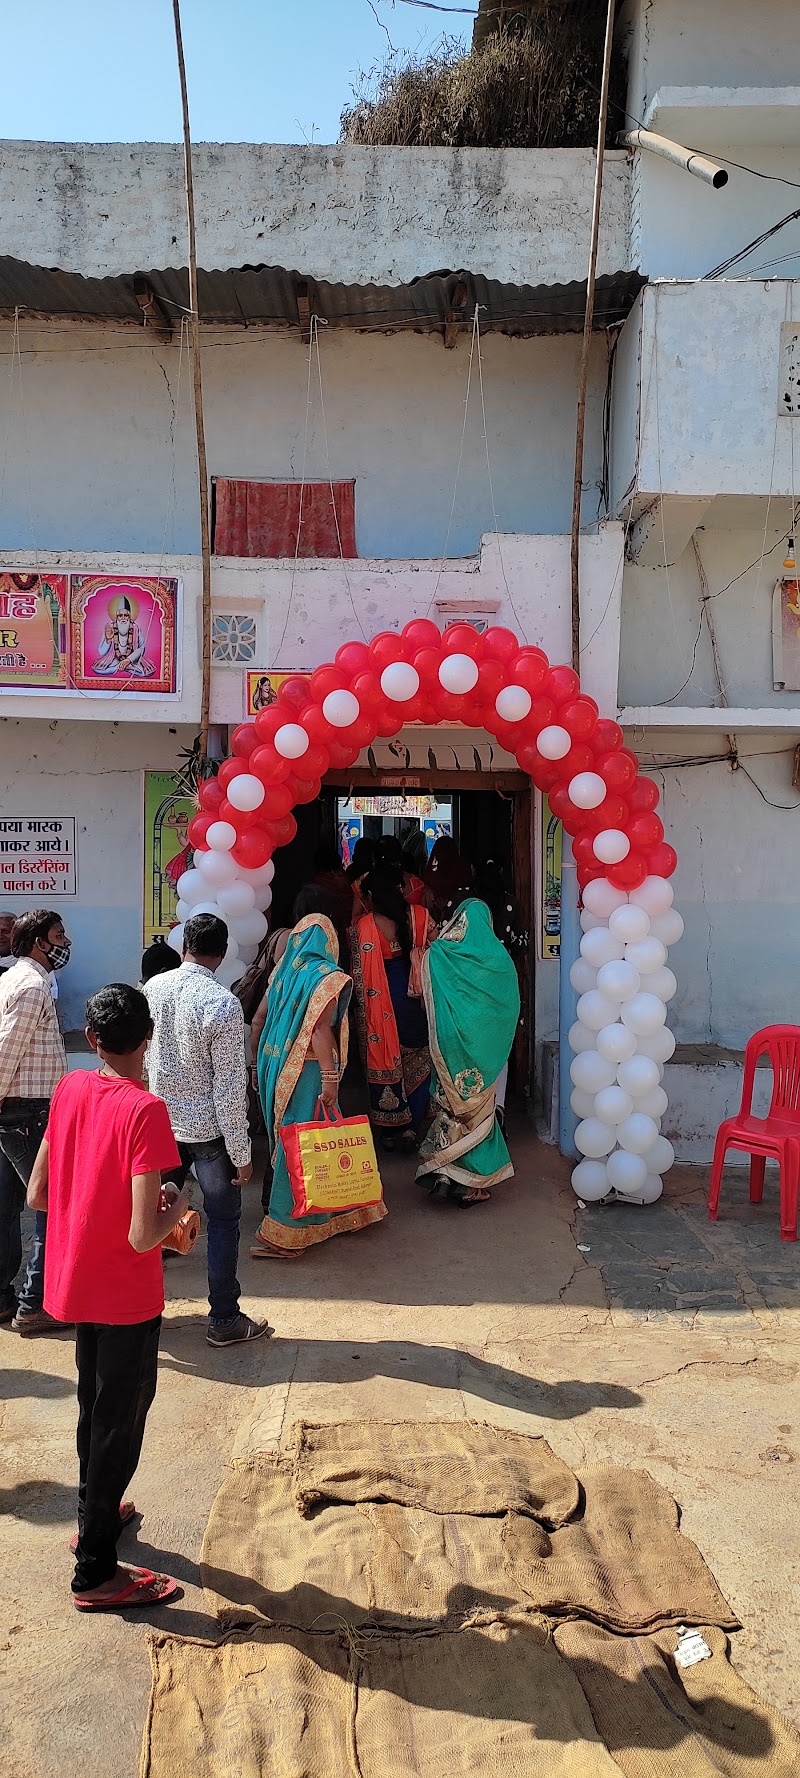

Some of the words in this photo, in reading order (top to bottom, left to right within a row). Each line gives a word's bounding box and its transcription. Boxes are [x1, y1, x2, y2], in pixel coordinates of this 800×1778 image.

[27, 821, 63, 832] मास्क
[18, 858, 70, 873] डिस्टेंसिंग
[3, 880, 34, 891] पालन
[313, 1140, 336, 1152] SSD
[338, 1136, 367, 1148] SALES
